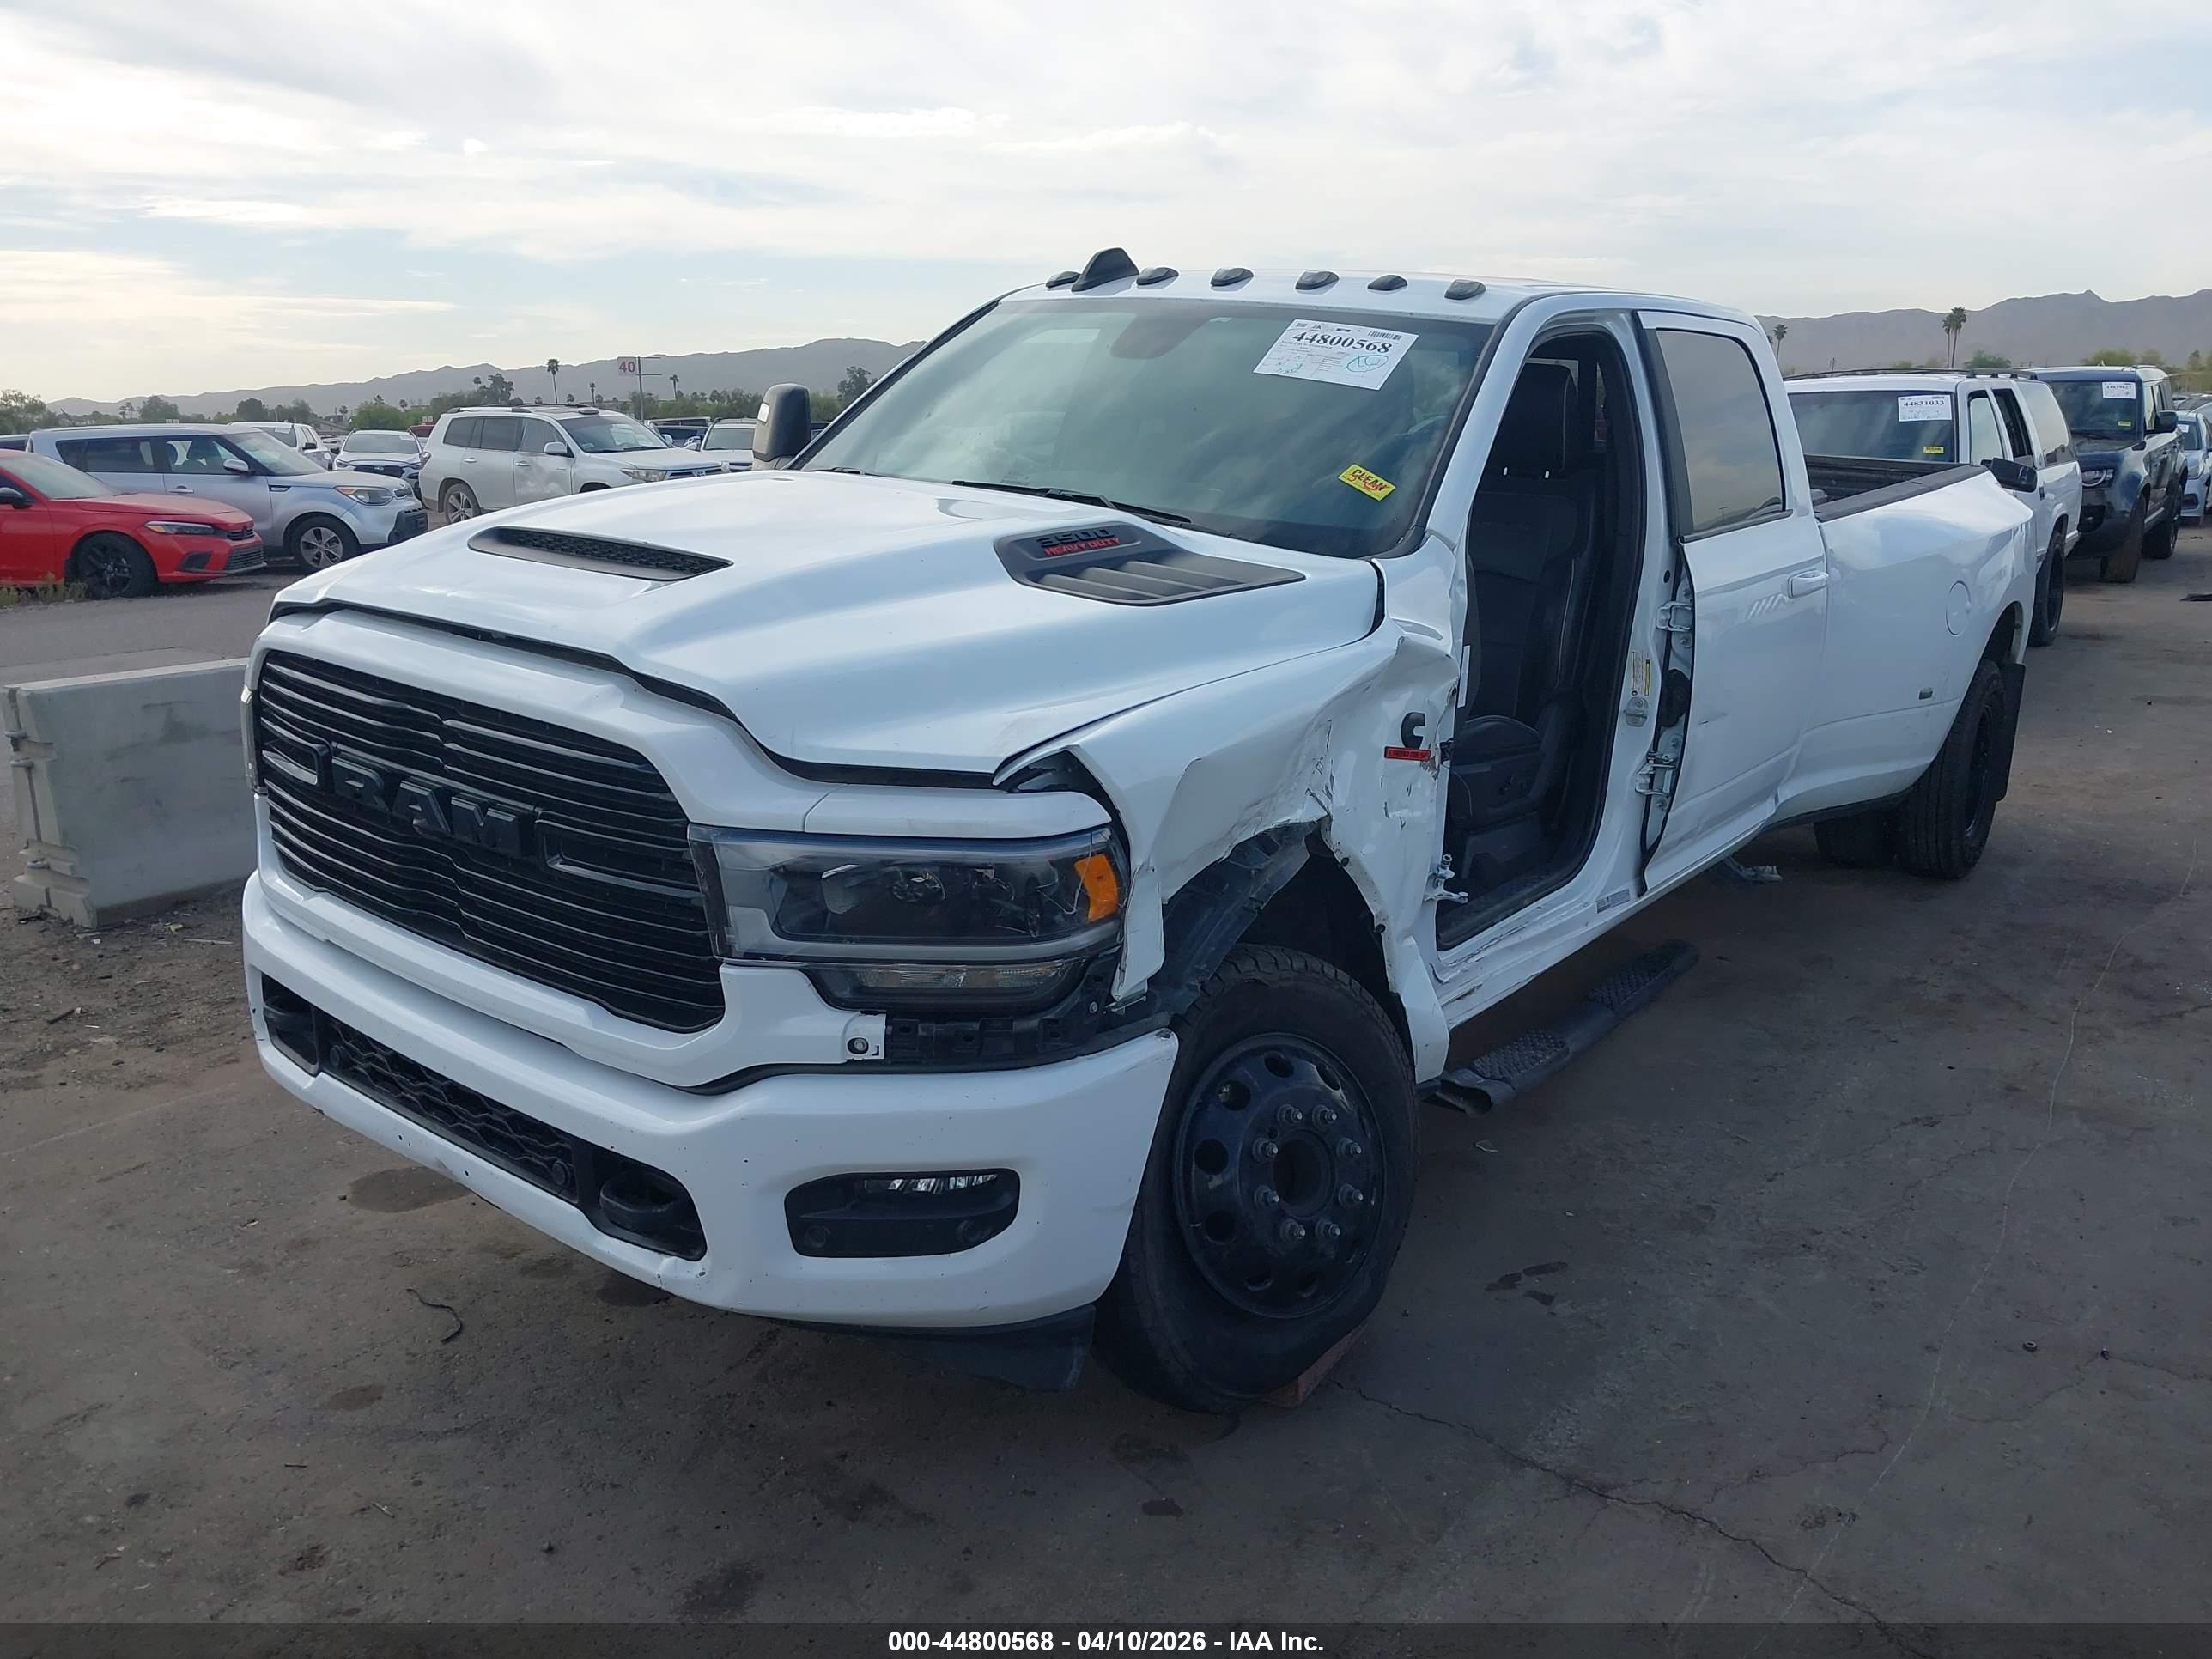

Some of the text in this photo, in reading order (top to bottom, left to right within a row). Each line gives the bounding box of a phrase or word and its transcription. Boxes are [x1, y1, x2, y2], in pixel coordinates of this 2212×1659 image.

[1292, 331, 1393, 354] 44800568
[618, 361, 636, 373] 40
[1036, 528, 1115, 548] 3500
[1043, 537, 1121, 556] HEAVY DUTY
[331, 755, 521, 858] RAM
